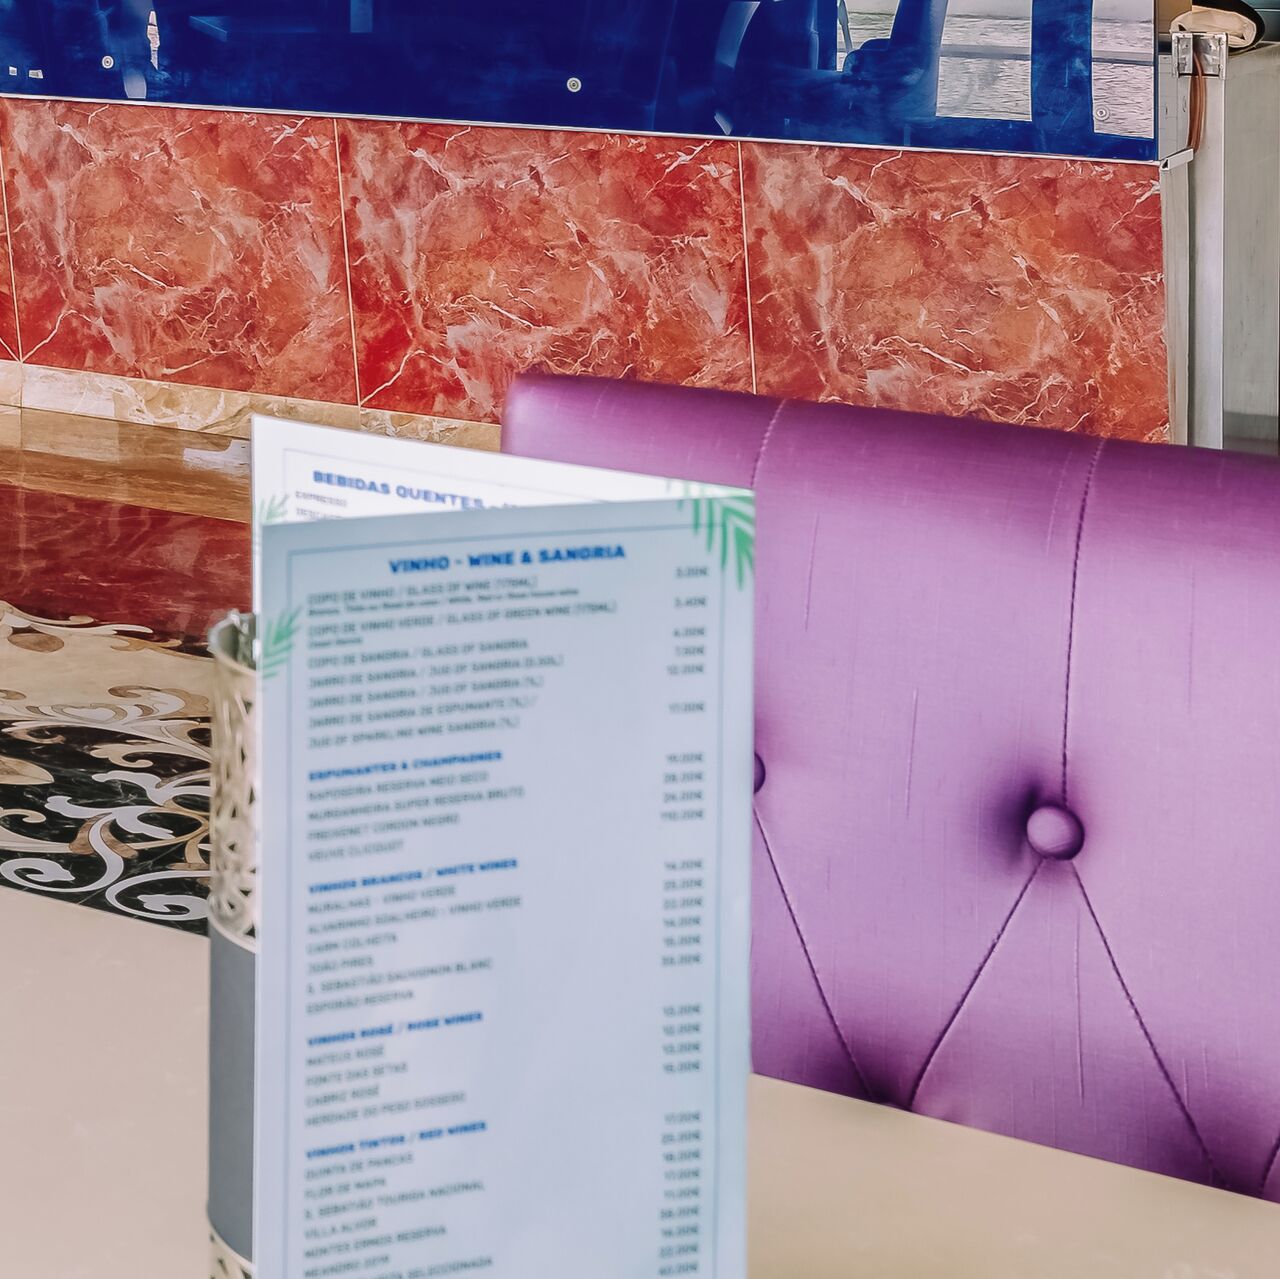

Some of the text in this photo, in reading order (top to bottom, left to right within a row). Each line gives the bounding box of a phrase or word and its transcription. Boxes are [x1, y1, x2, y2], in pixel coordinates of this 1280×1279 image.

[313, 470, 484, 511] BEBIDAS QUENTES
[389, 545, 625, 574] VINHO WINE & SANGRIA
[464, 580, 491, 594] WINE
[544, 604, 571, 619] WINE
[416, 723, 443, 739] WINE
